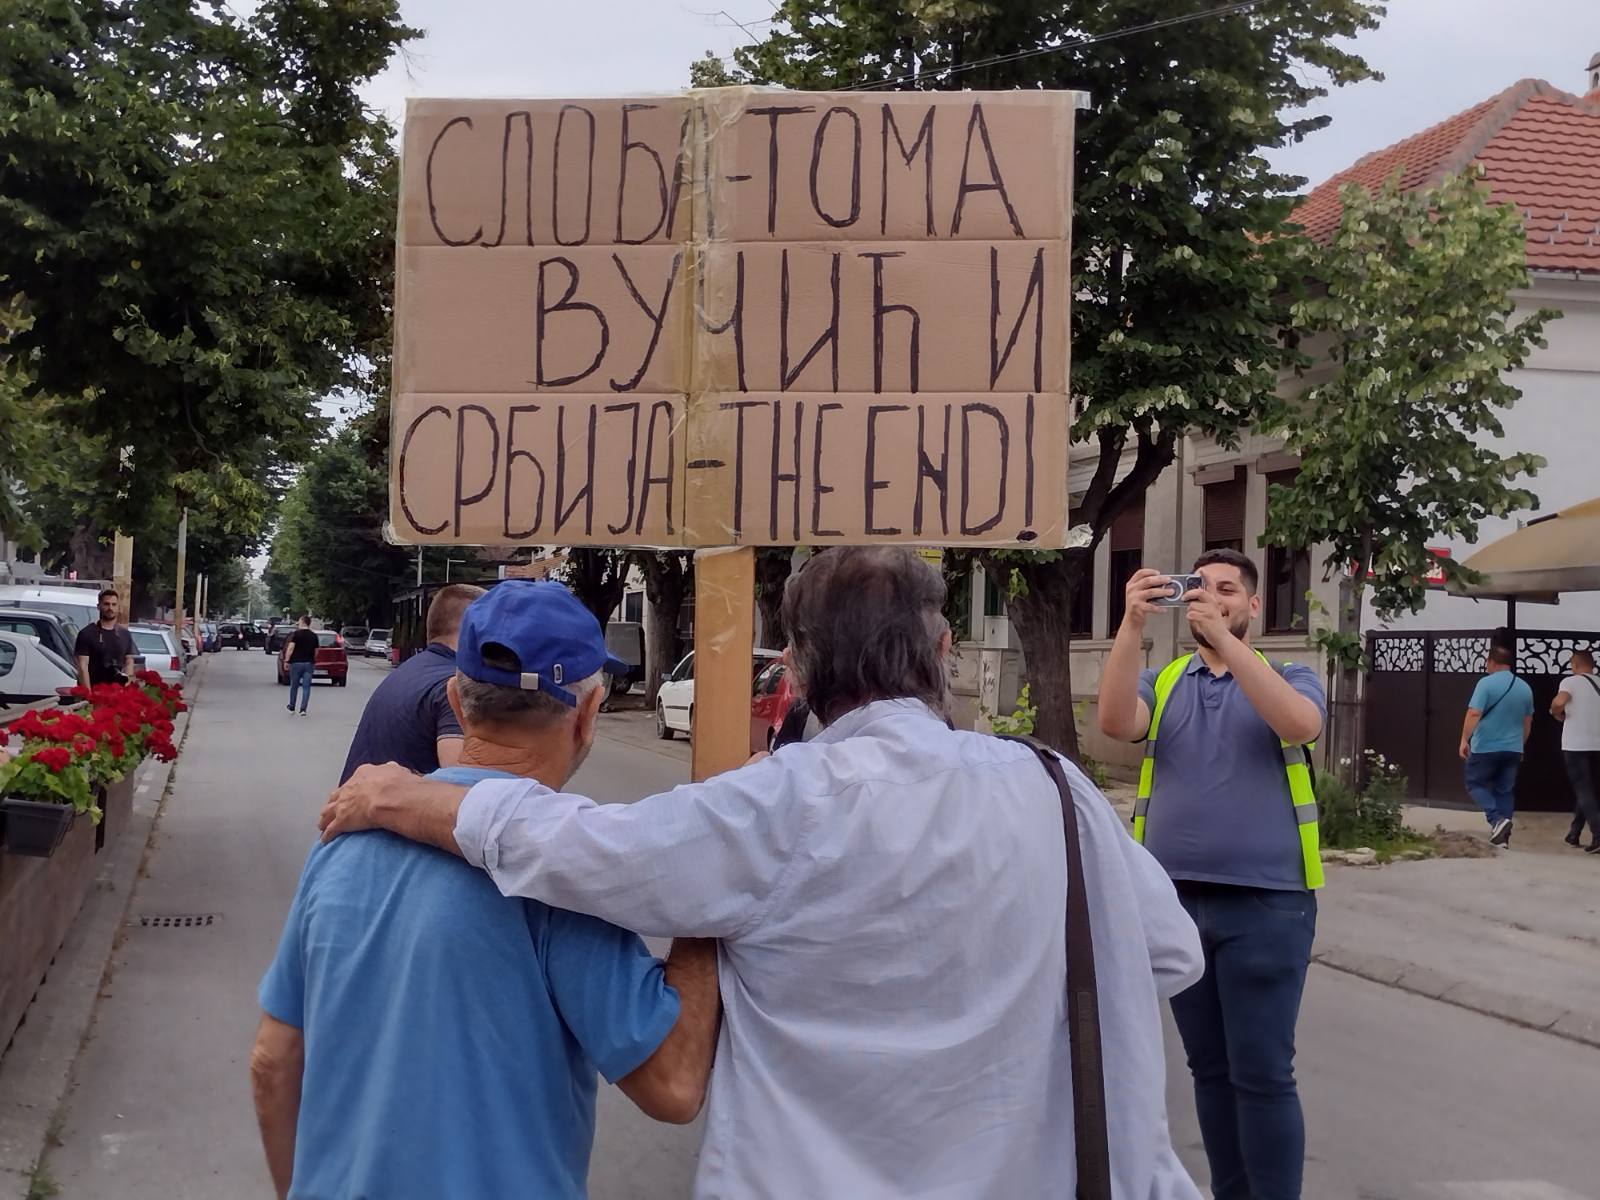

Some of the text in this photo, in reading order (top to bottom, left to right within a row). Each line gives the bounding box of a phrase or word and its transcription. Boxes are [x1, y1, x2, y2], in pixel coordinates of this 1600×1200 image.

[530, 246, 1046, 393] ВУЧИЋ И
[864, 393, 1039, 543] END!
